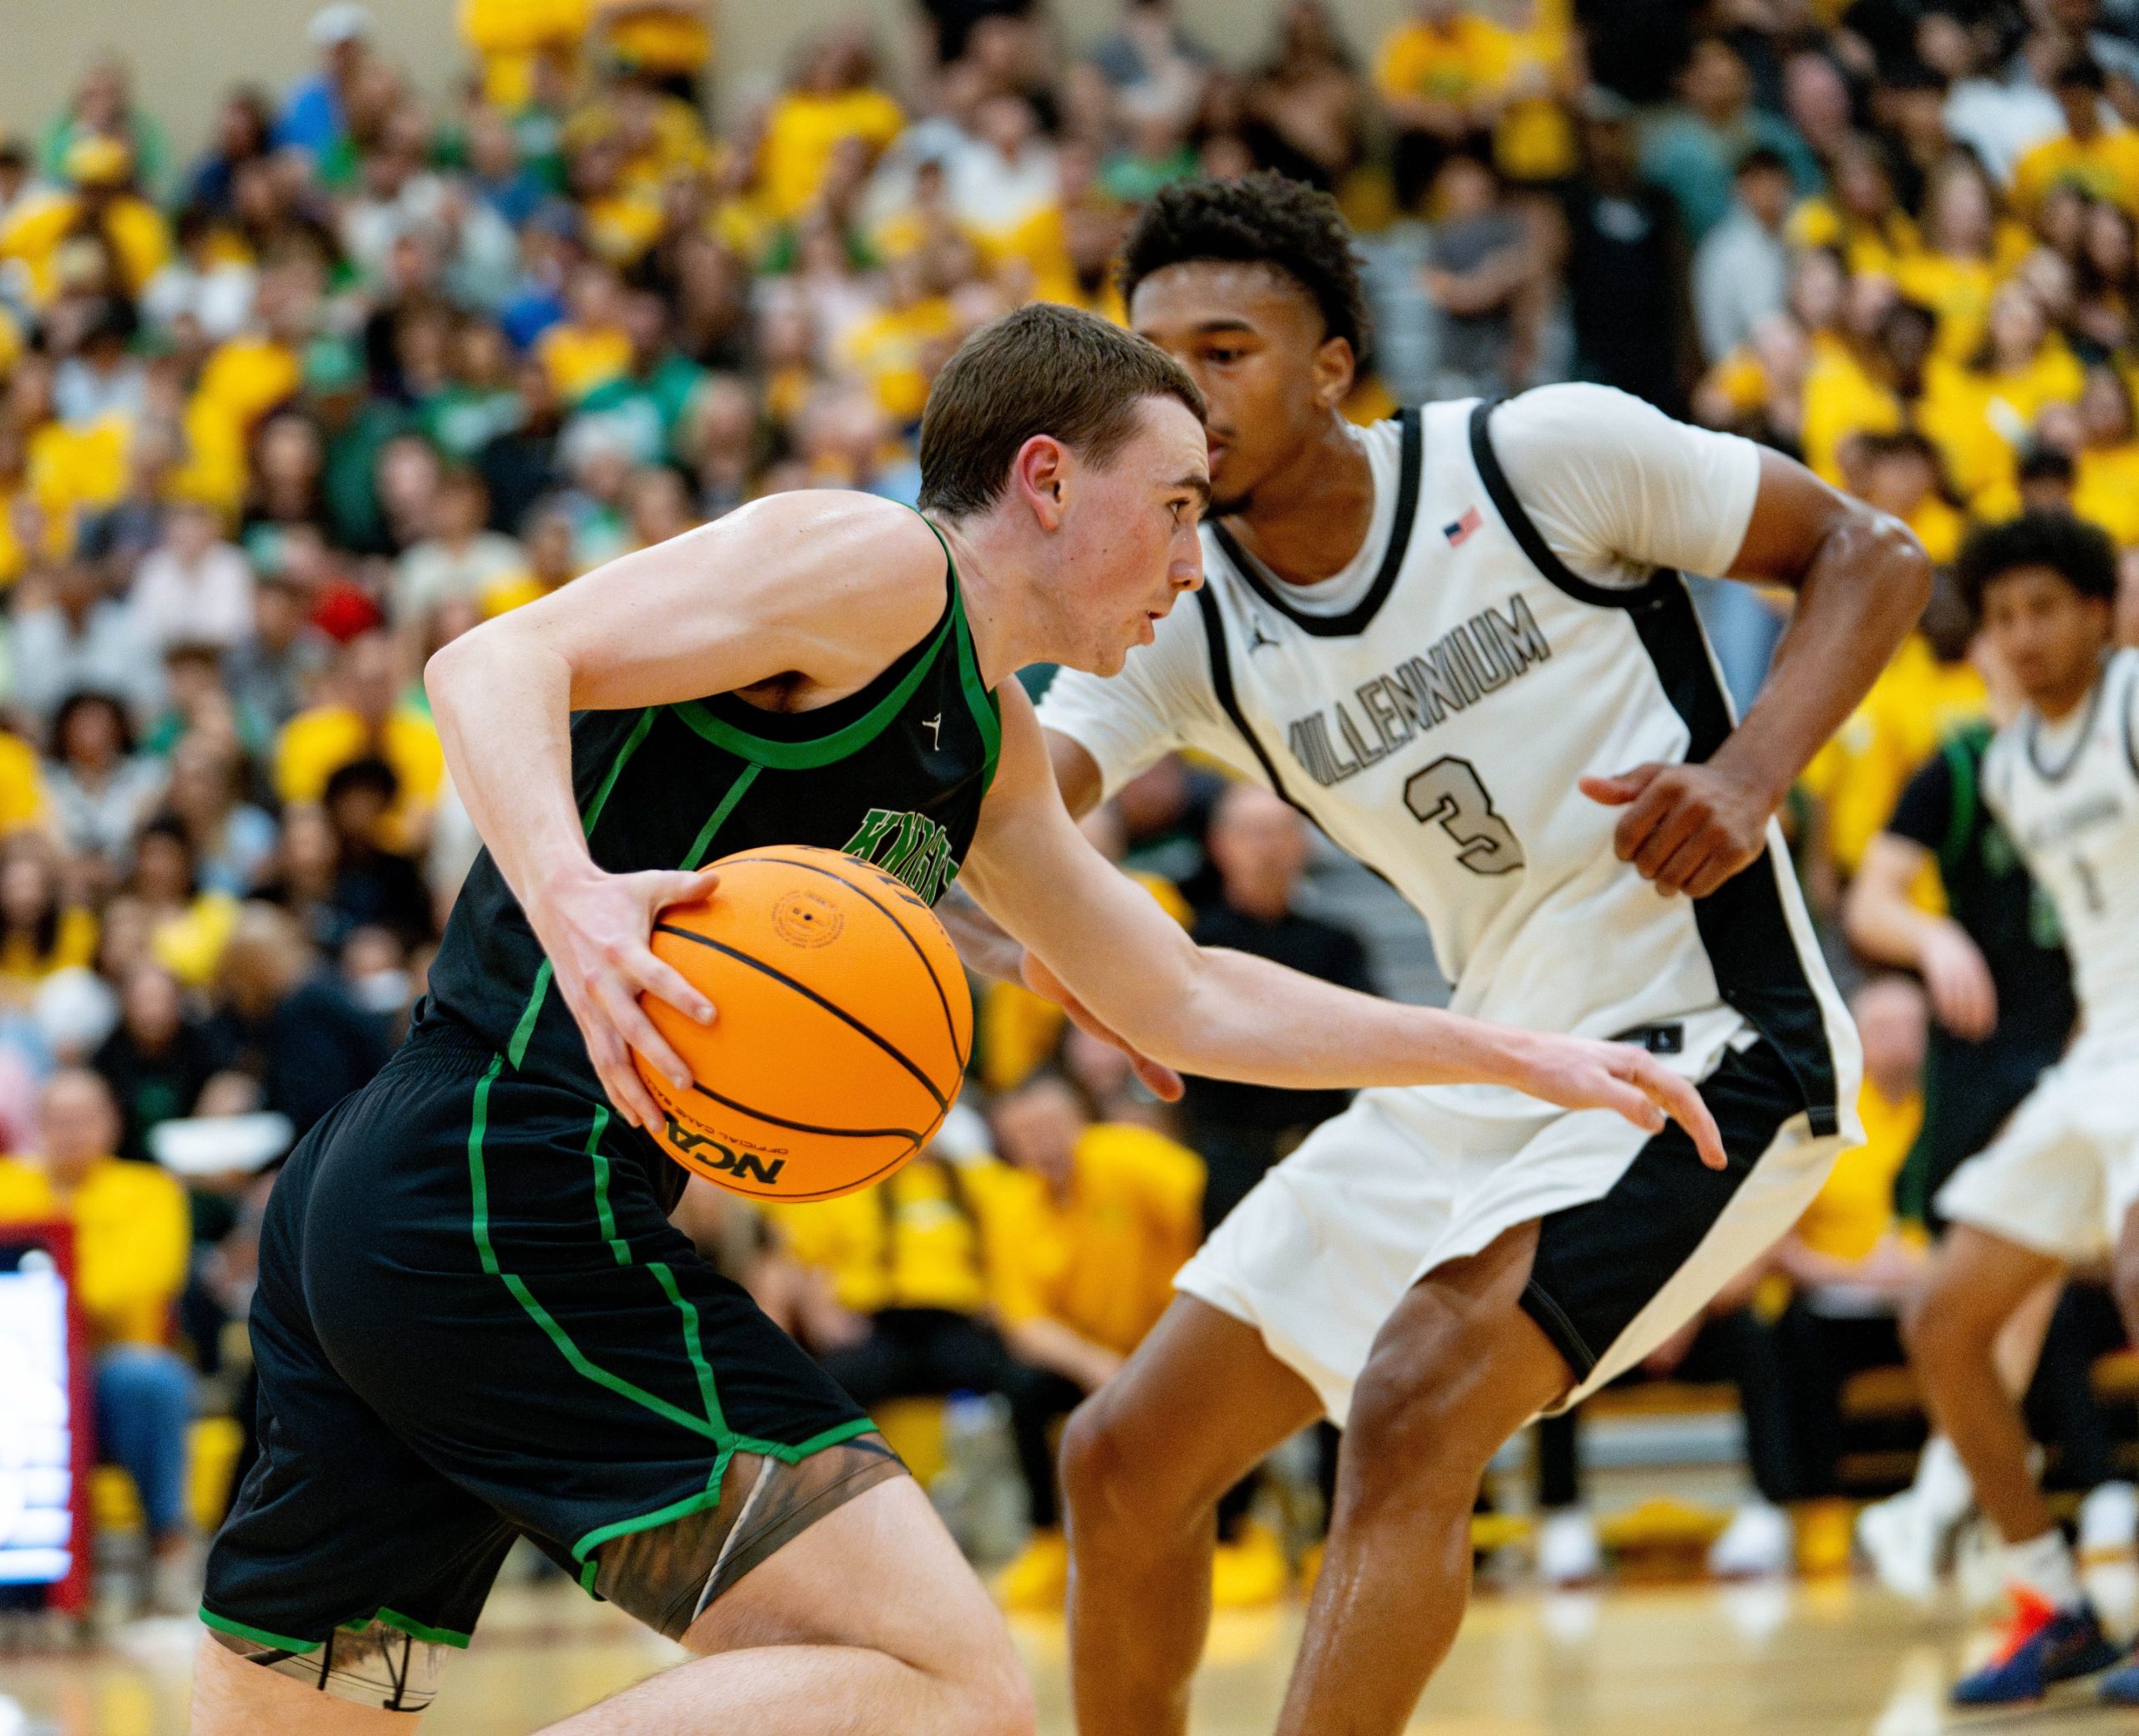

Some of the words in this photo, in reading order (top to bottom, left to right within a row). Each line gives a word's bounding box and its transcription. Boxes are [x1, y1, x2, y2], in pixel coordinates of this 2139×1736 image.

[841, 808, 960, 906] KNIGH
[1403, 754, 1526, 876] 3
[662, 1109, 786, 1185] NCA
